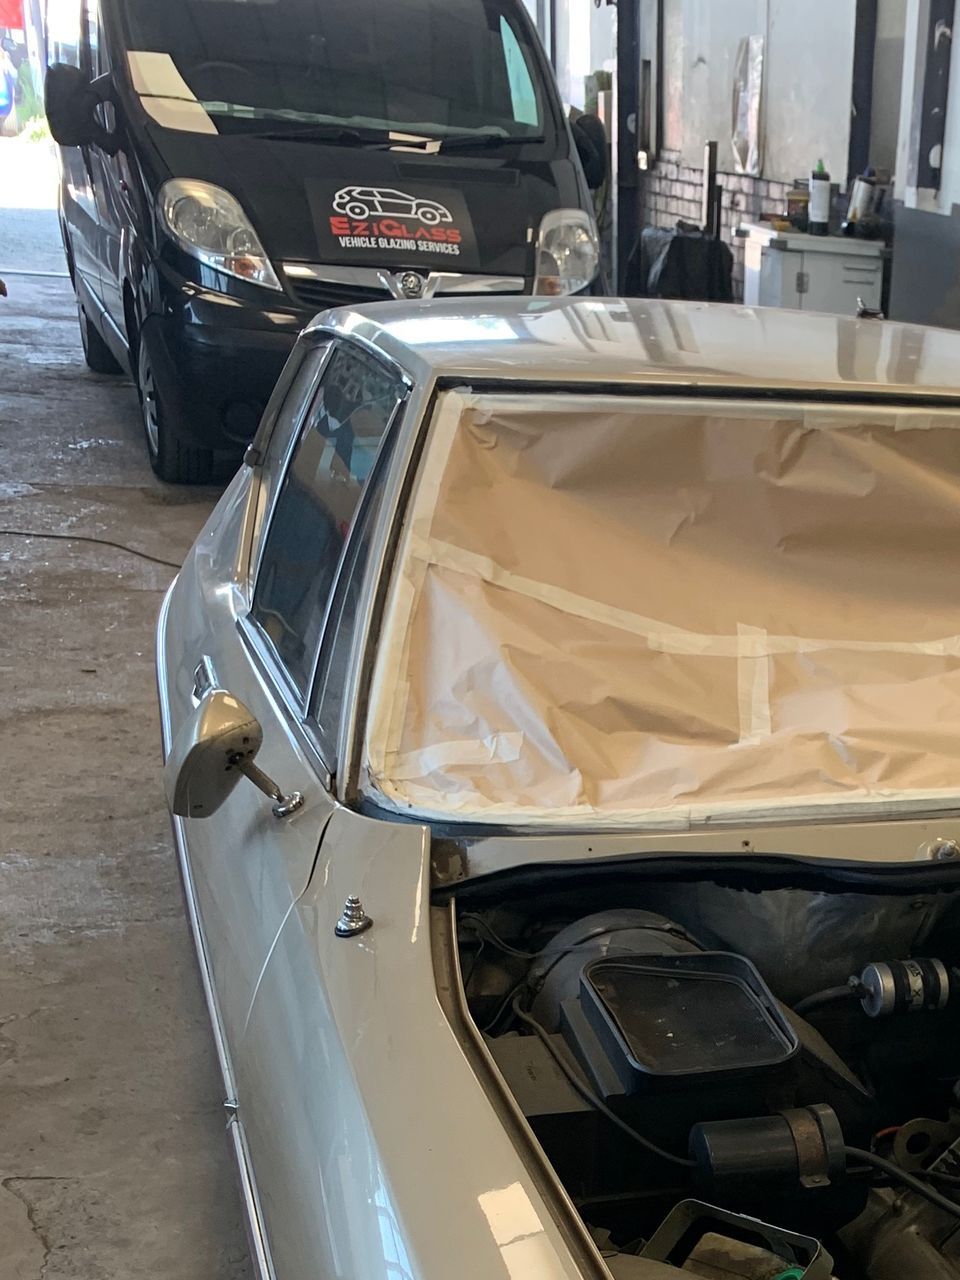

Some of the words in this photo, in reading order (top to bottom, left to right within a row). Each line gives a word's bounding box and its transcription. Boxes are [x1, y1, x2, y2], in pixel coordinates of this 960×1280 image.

[338, 236, 378, 248] VEHICLE
[378, 237, 416, 251] GLAZING
[417, 240, 460, 255] SERVICES
